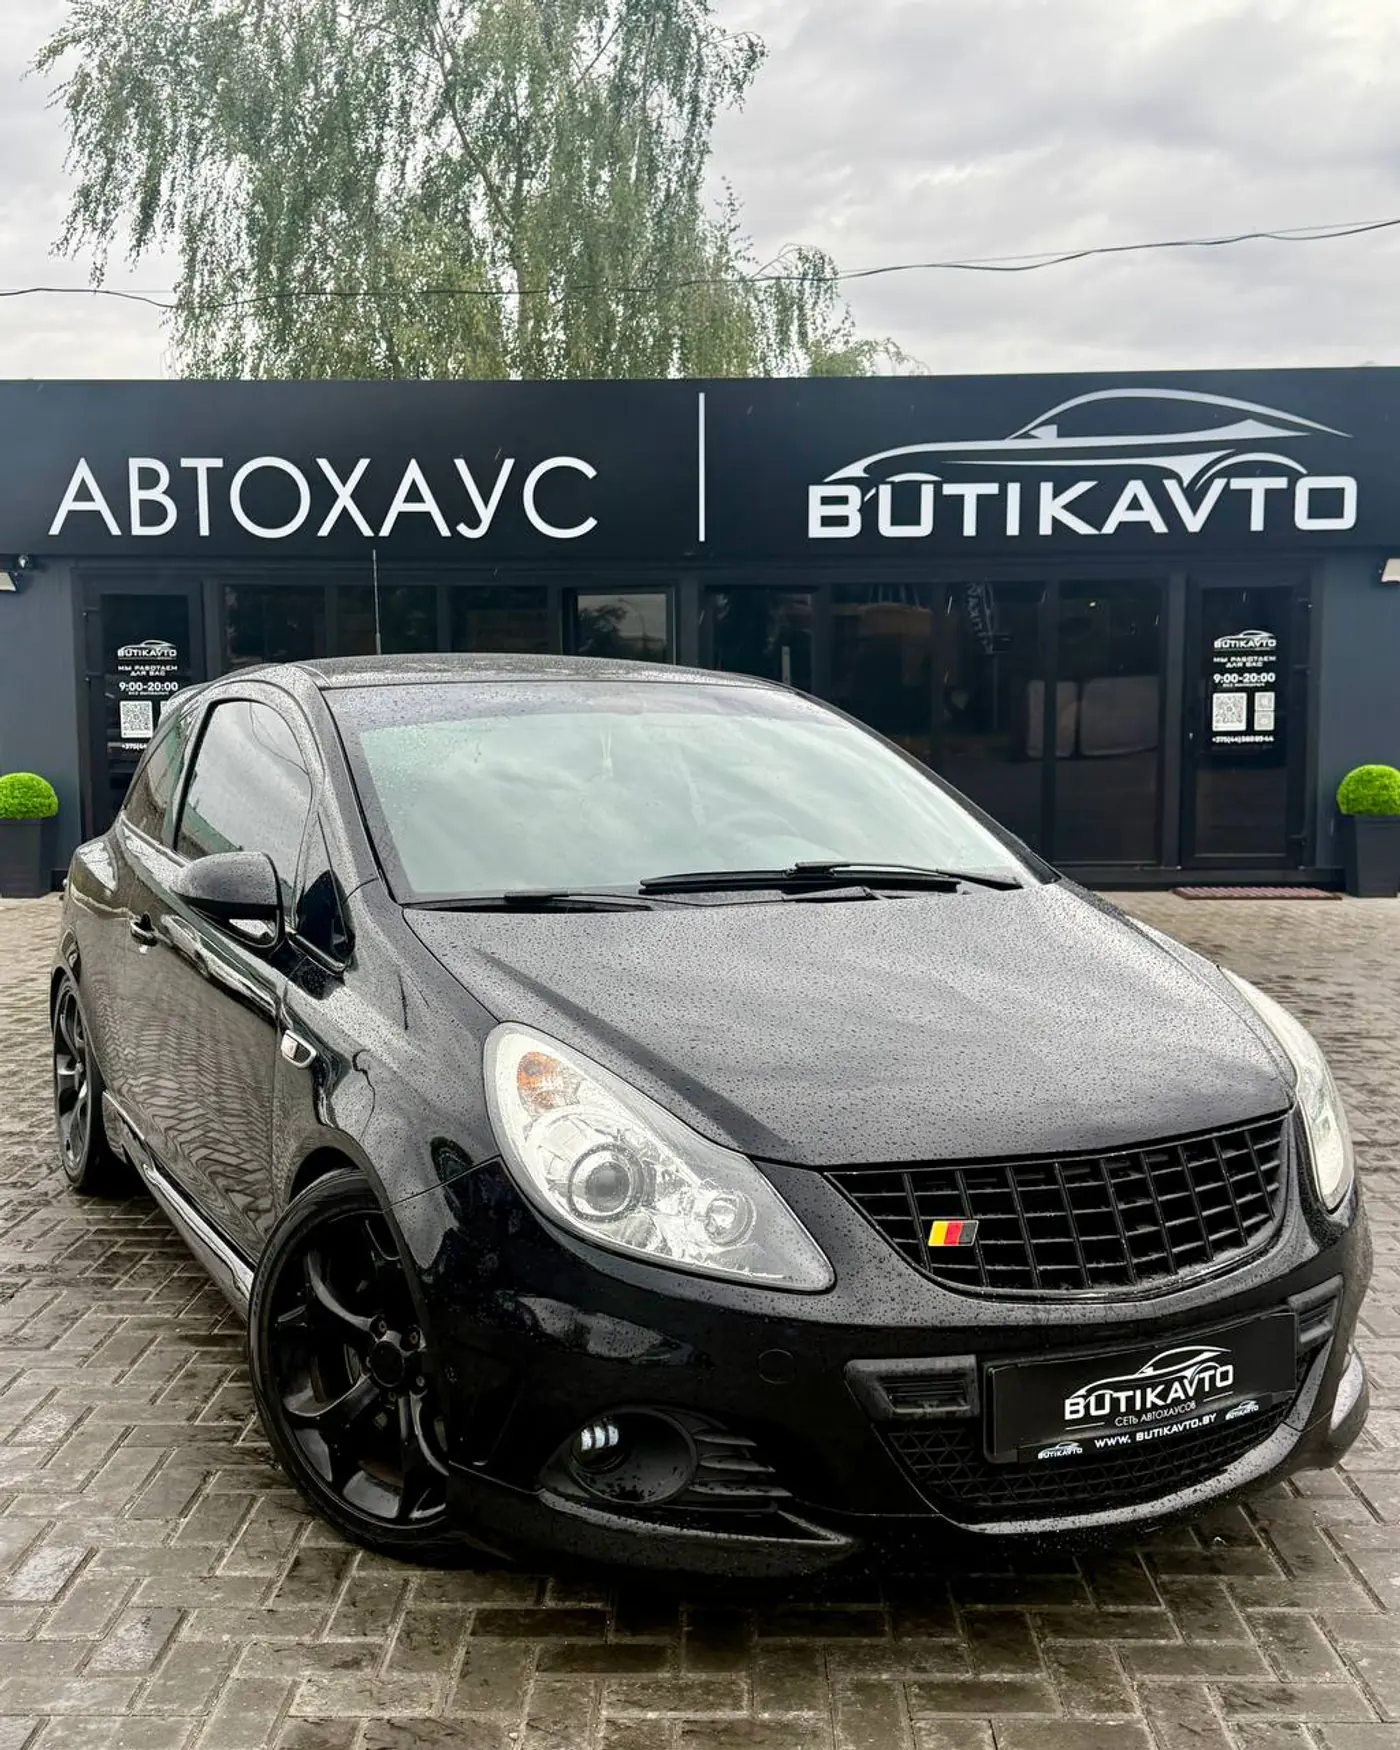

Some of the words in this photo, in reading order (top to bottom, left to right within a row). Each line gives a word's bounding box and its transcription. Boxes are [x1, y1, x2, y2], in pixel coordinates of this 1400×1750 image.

[48, 456, 598, 539] АВТОХАУС
[807, 475, 1358, 539] BUTIKAVTO
[117, 648, 177, 657] BUTIKAVTO
[1213, 639, 1277, 648] BUTIKAVTO
[118, 681, 179, 691] 9:00-20:00
[1213, 672, 1276, 683] 9:00-20:00
[1064, 1364, 1234, 1420] BUTIKAVTO
[1115, 1415, 1139, 1427] СЕТЬ
[1140, 1401, 1196, 1423] АВТОХАУСОВ
[1094, 1434, 1131, 1448] WWW.
[1135, 1413, 1217, 1442] BUTIKAVTO.BY
[1037, 1447, 1083, 1460] BUTIKAVTO
